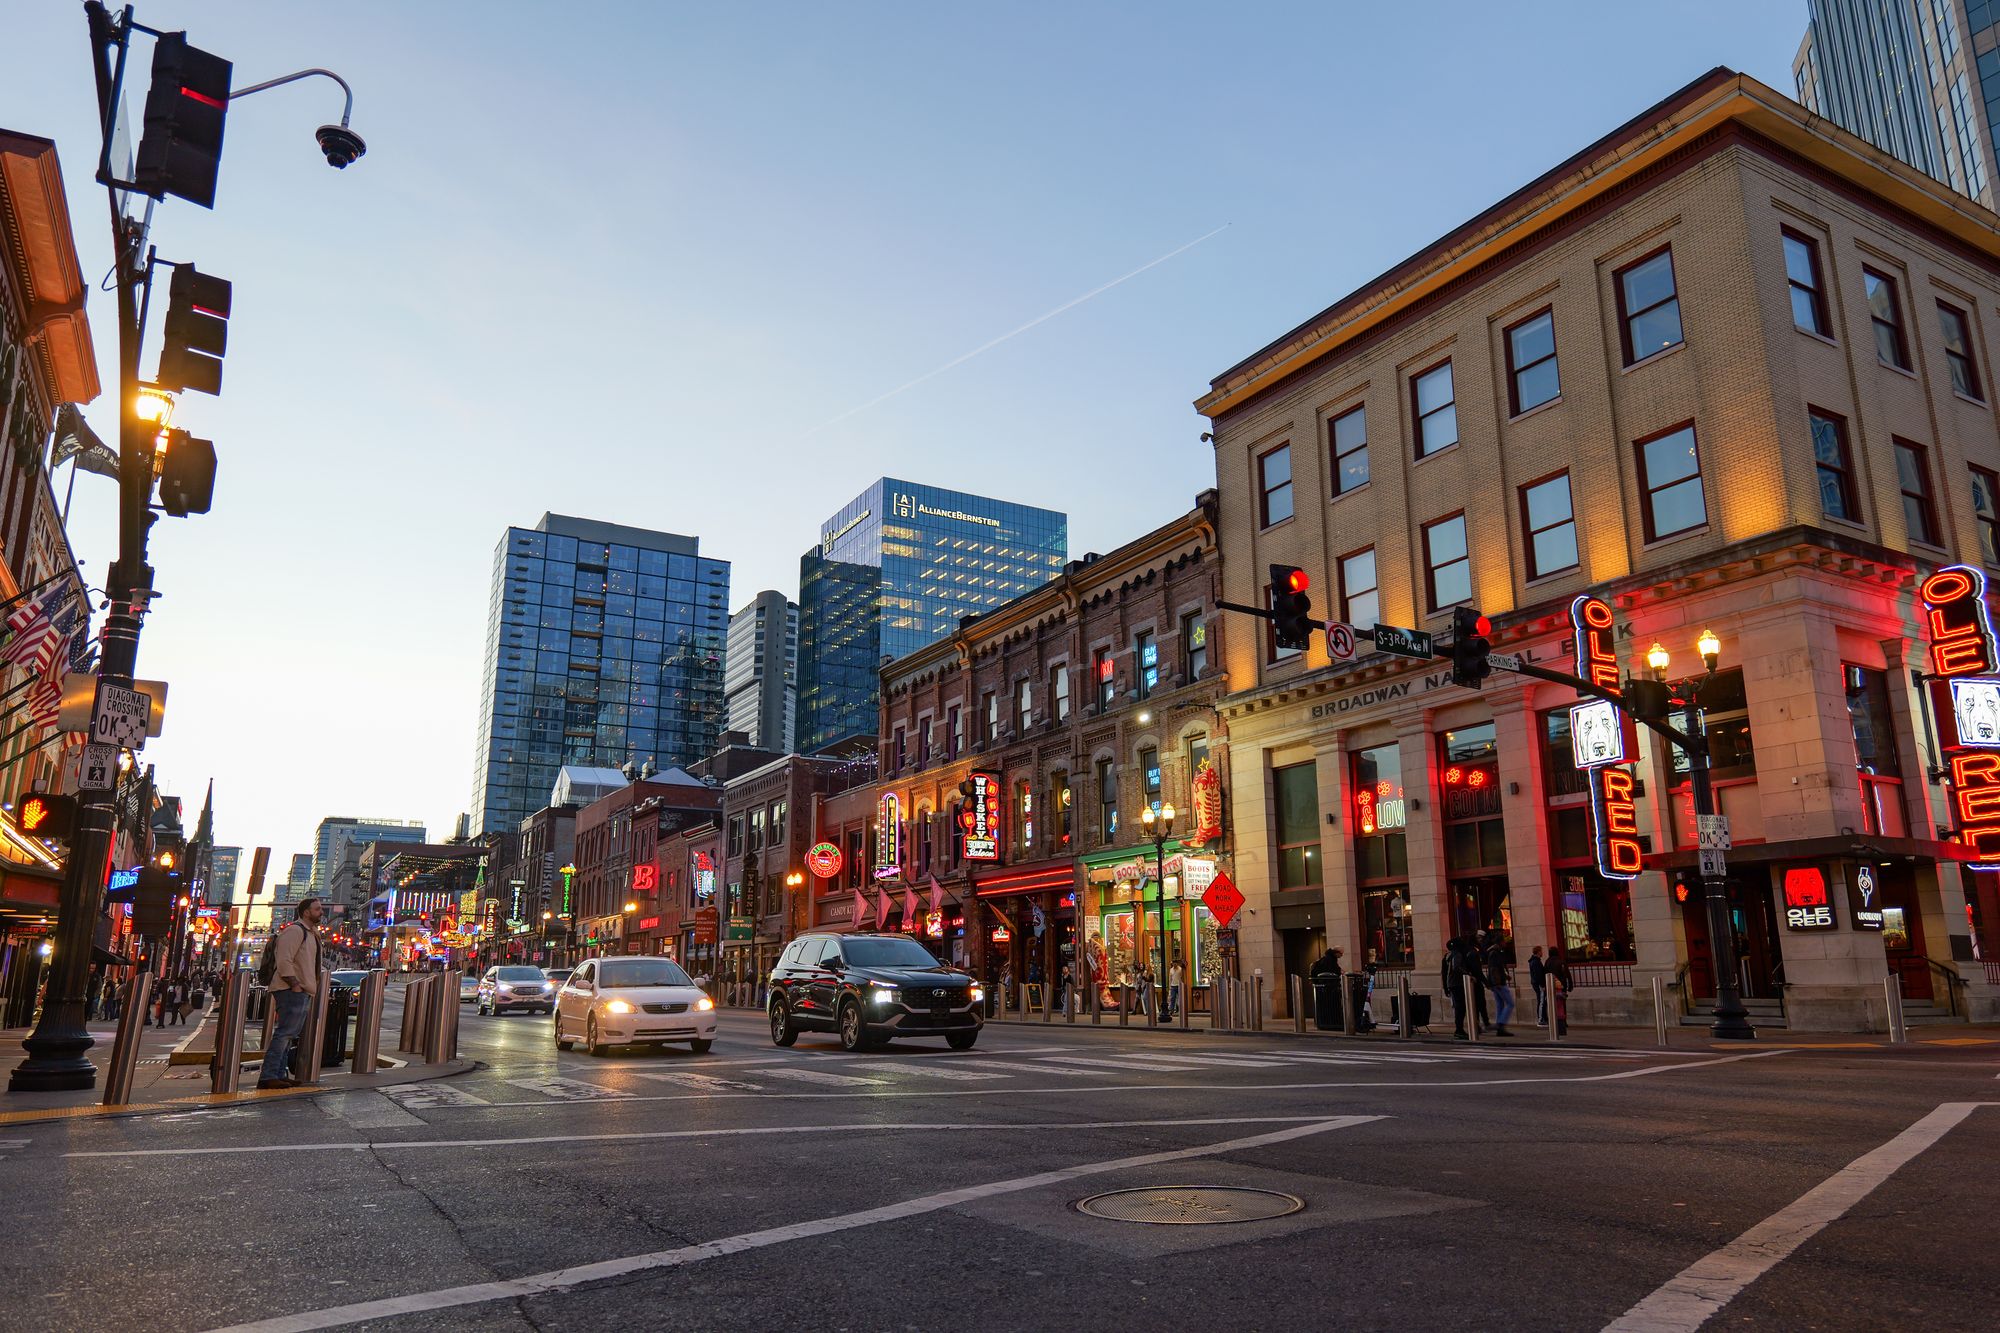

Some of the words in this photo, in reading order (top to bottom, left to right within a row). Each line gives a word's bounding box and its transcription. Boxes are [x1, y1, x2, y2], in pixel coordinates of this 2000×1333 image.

[900, 494, 909, 504] A
[900, 508, 909, 517] B
[1922, 571, 1984, 677] OLE
[1422, 640, 1429, 653] N
[1585, 600, 1621, 696] OLE
[107, 687, 145, 707] DIAGONAL
[1311, 681, 1411, 719] BROADWAY
[106, 699, 144, 718] CROSSING
[99, 714, 119, 738] OK
[93, 759, 104, 767] ON
[83, 781, 106, 789] SIGNAL
[974, 776, 987, 840] WHISKEY
[1376, 800, 1406, 829] LOV
[1603, 770, 1641, 872] RED
[1700, 815, 1726, 823] DIAGONAL
[888, 799, 896, 862] MIRANDA
[1701, 822, 1726, 830] CROSSING
[1699, 831, 1713, 844] OK
[966, 847, 995, 857] Saloon
[1147, 855, 1184, 877] CONTRY
[1187, 864, 1210, 872] BOOTS
[541, 852, 555, 900] WHISKEY
[632, 865, 655, 890] B
[830, 907, 847, 917] CANDY
[1214, 904, 1235, 913] AHEAD
[1787, 906, 1830, 919] OLE
[1788, 915, 1832, 927] RED
[1857, 911, 1882, 921] LOOKOUT
